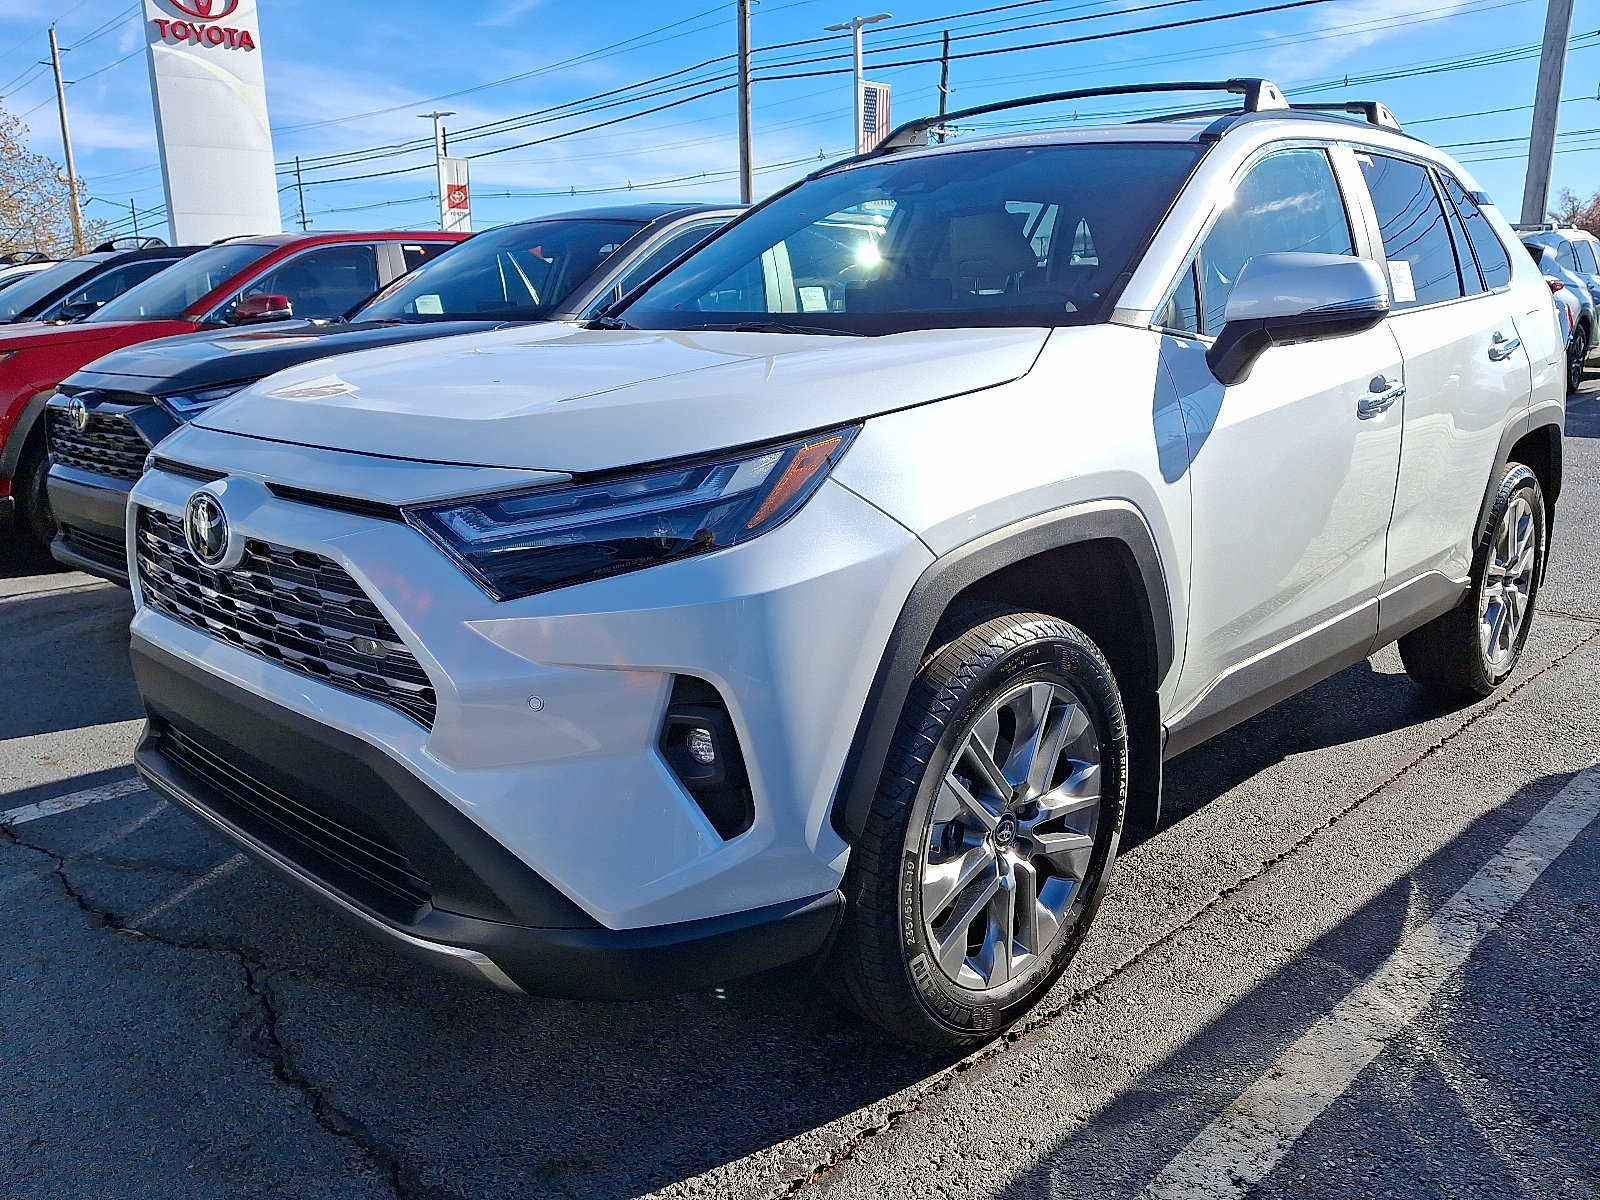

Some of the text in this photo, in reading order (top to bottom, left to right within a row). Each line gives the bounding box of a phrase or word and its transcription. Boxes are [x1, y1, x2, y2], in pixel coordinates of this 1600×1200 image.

[154, 18, 256, 50] TOYOTA
[1118, 748, 1127, 807] PRIMACY
[904, 861, 916, 946] 235/55 R 19
[912, 959, 972, 1026] MICHELIN
